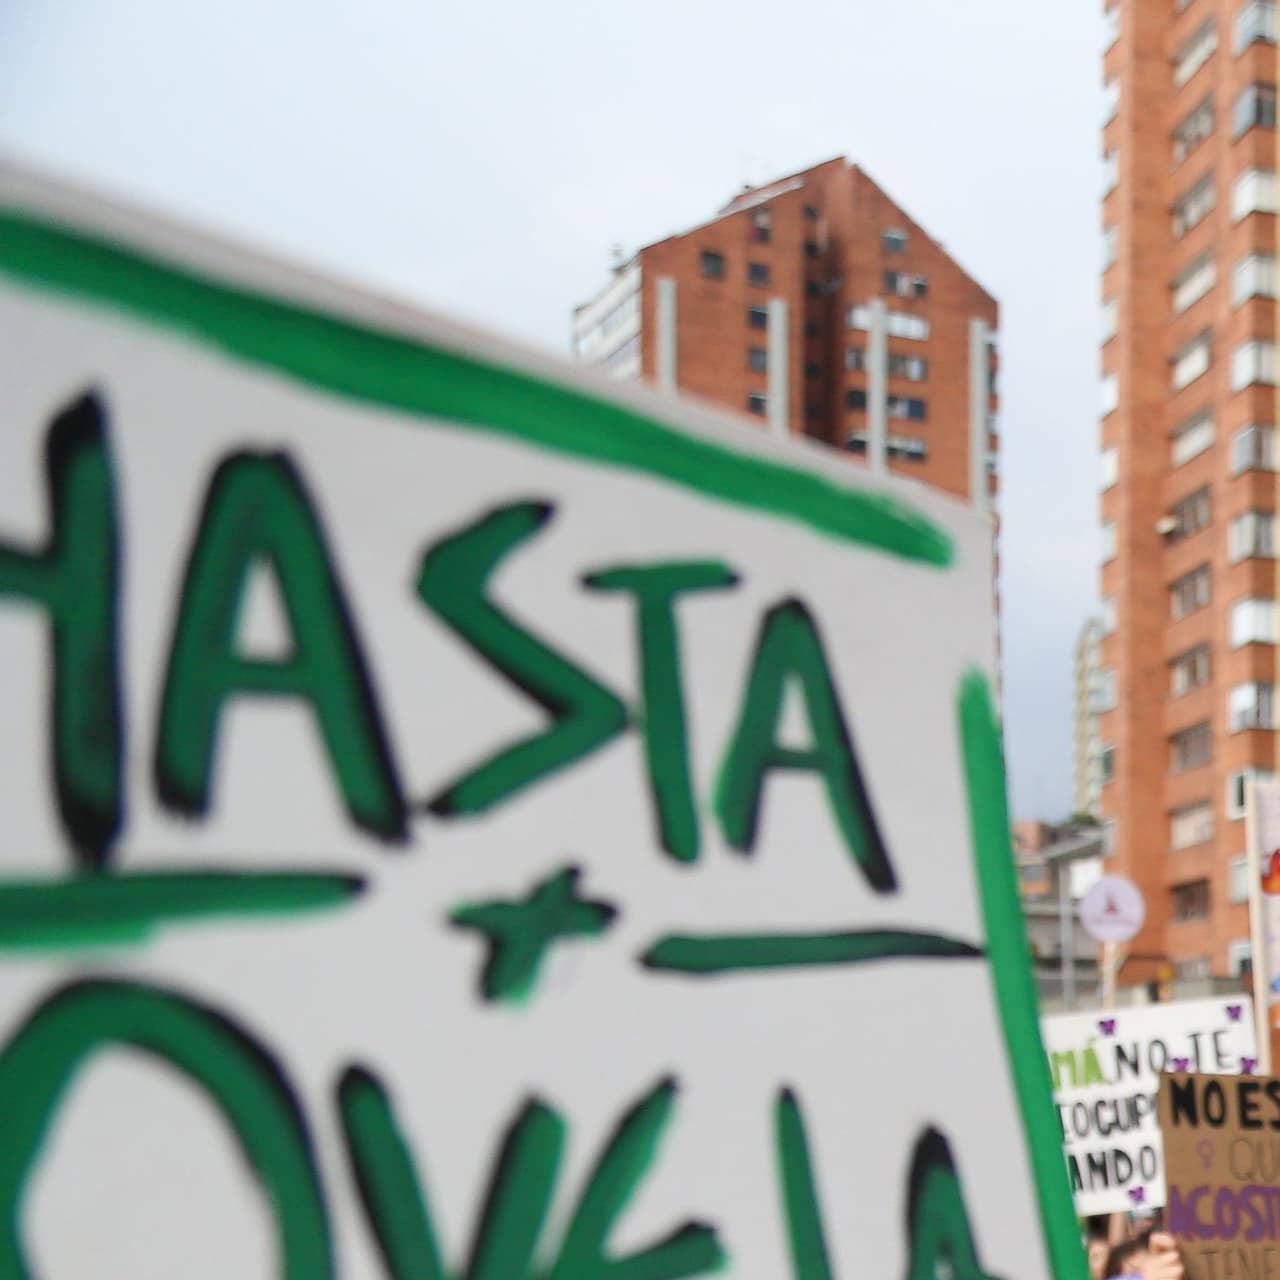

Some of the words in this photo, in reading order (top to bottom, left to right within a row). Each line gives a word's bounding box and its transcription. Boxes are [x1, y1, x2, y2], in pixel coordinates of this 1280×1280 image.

[0, 378, 898, 893] HASTA
[1116, 1039, 1168, 1078] NO
[1189, 1030, 1232, 1073] TE
[1169, 1078, 1226, 1128] NO
